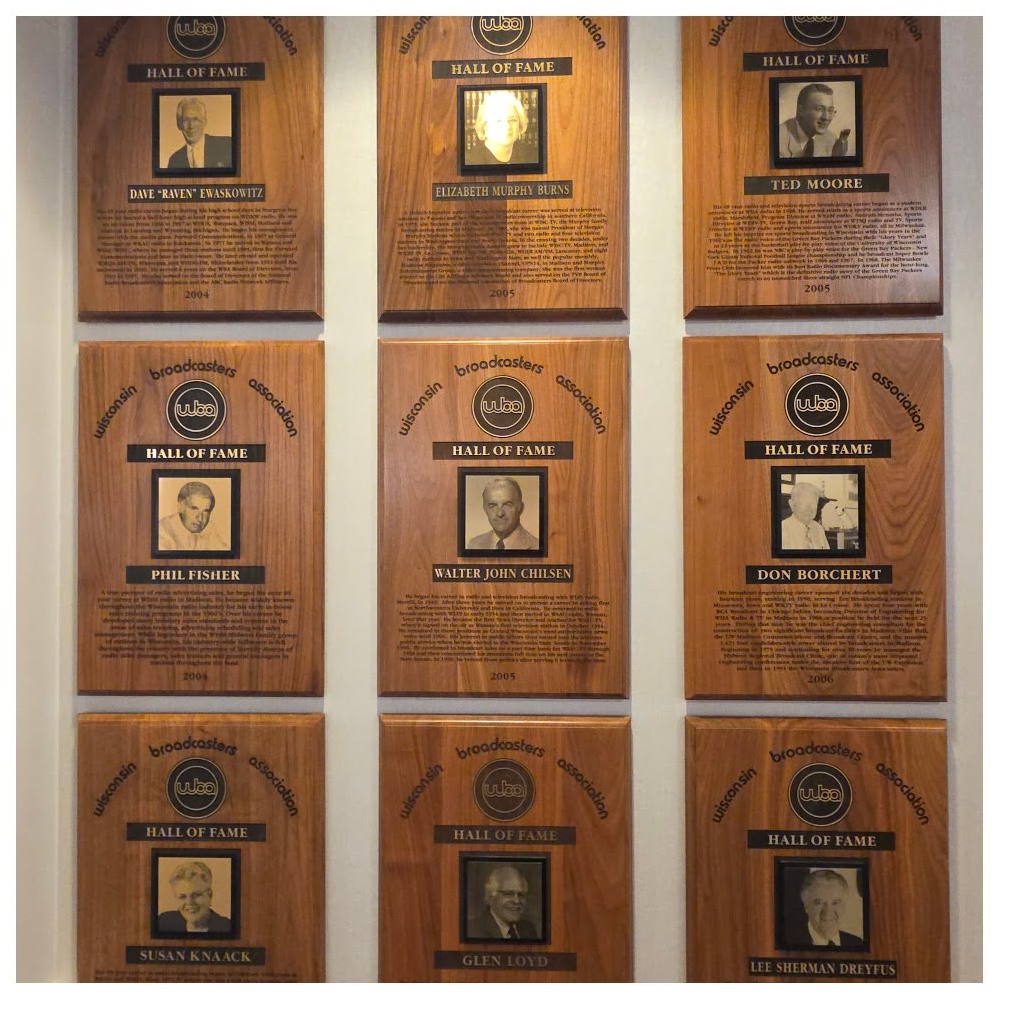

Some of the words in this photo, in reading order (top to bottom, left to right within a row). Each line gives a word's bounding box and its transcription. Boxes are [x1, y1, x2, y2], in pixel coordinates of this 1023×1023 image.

[763, 56, 801, 66] HALL
[805, 55, 825, 65] OF
[829, 54, 869, 64] FAME
[147, 69, 184, 78] HALL
[187, 68, 206, 77] OF
[209, 67, 247, 77] FAME
[451, 65, 489, 74] HALL
[492, 63, 511, 73] OF
[515, 62, 555, 72] FAME
[771, 180, 801, 190] TED
[807, 179, 863, 189] MOORE
[130, 189, 155, 199] DAVE
[200, 188, 263, 199] EWASKOWITZ
[436, 187, 489, 197] ELIZABETH
[493, 186, 534, 196] MURPHY
[538, 185, 569, 195] BURNS
[94, 384, 138, 439] wisconsin
[149, 359, 237, 381] broadcasters
[248, 378, 298, 437] association
[398, 381, 443, 437] wisconsin
[454, 354, 544, 377] broadcasters
[556, 374, 606, 435] association
[709, 379, 754, 436] wisconsin
[767, 352, 859, 375] broadcasters
[872, 372, 925, 433] association
[146, 449, 184, 459] HALL
[187, 448, 206, 459] OF
[209, 448, 248, 459] FAME
[452, 445, 490, 456] HALL
[493, 445, 512, 456] OF
[516, 445, 555, 455] FAME
[765, 444, 804, 455] HALL
[808, 444, 828, 455] OF
[832, 444, 873, 455] FAME
[151, 570, 185, 580] PHIL
[189, 570, 240, 581] FISHER
[434, 568, 481, 579] WALTER
[484, 568, 516, 580] JOHN
[520, 567, 572, 578] CHILSEN
[758, 570, 792, 580] DON
[797, 569, 882, 581] BORCHERT
[93, 762, 137, 817] wisconsin
[149, 736, 238, 757] broadcasters
[249, 756, 299, 817] association
[400, 762, 444, 819] wisconsin
[456, 738, 545, 759] broadcasters
[557, 758, 609, 820] association
[712, 767, 757, 823] wisconsin
[769, 742, 862, 762] broadcasters
[876, 762, 929, 825] association
[146, 827, 183, 837] HALL
[187, 827, 205, 837] OF
[210, 828, 248, 837] FAME
[454, 830, 491, 840] HALL
[495, 830, 514, 840] OF
[518, 830, 557, 841] FAME
[768, 835, 807, 845] HALL
[811, 835, 831, 846] OF
[835, 836, 876, 846] FAME
[140, 951, 185, 961] SUSAN
[190, 951, 250, 962] KNAACK
[463, 956, 500, 966] GLEN
[508, 957, 548, 967] LOYD
[751, 962, 771, 972] LEE
[776, 963, 835, 974] SHERMAN
[840, 963, 895, 975] DREYFUS
